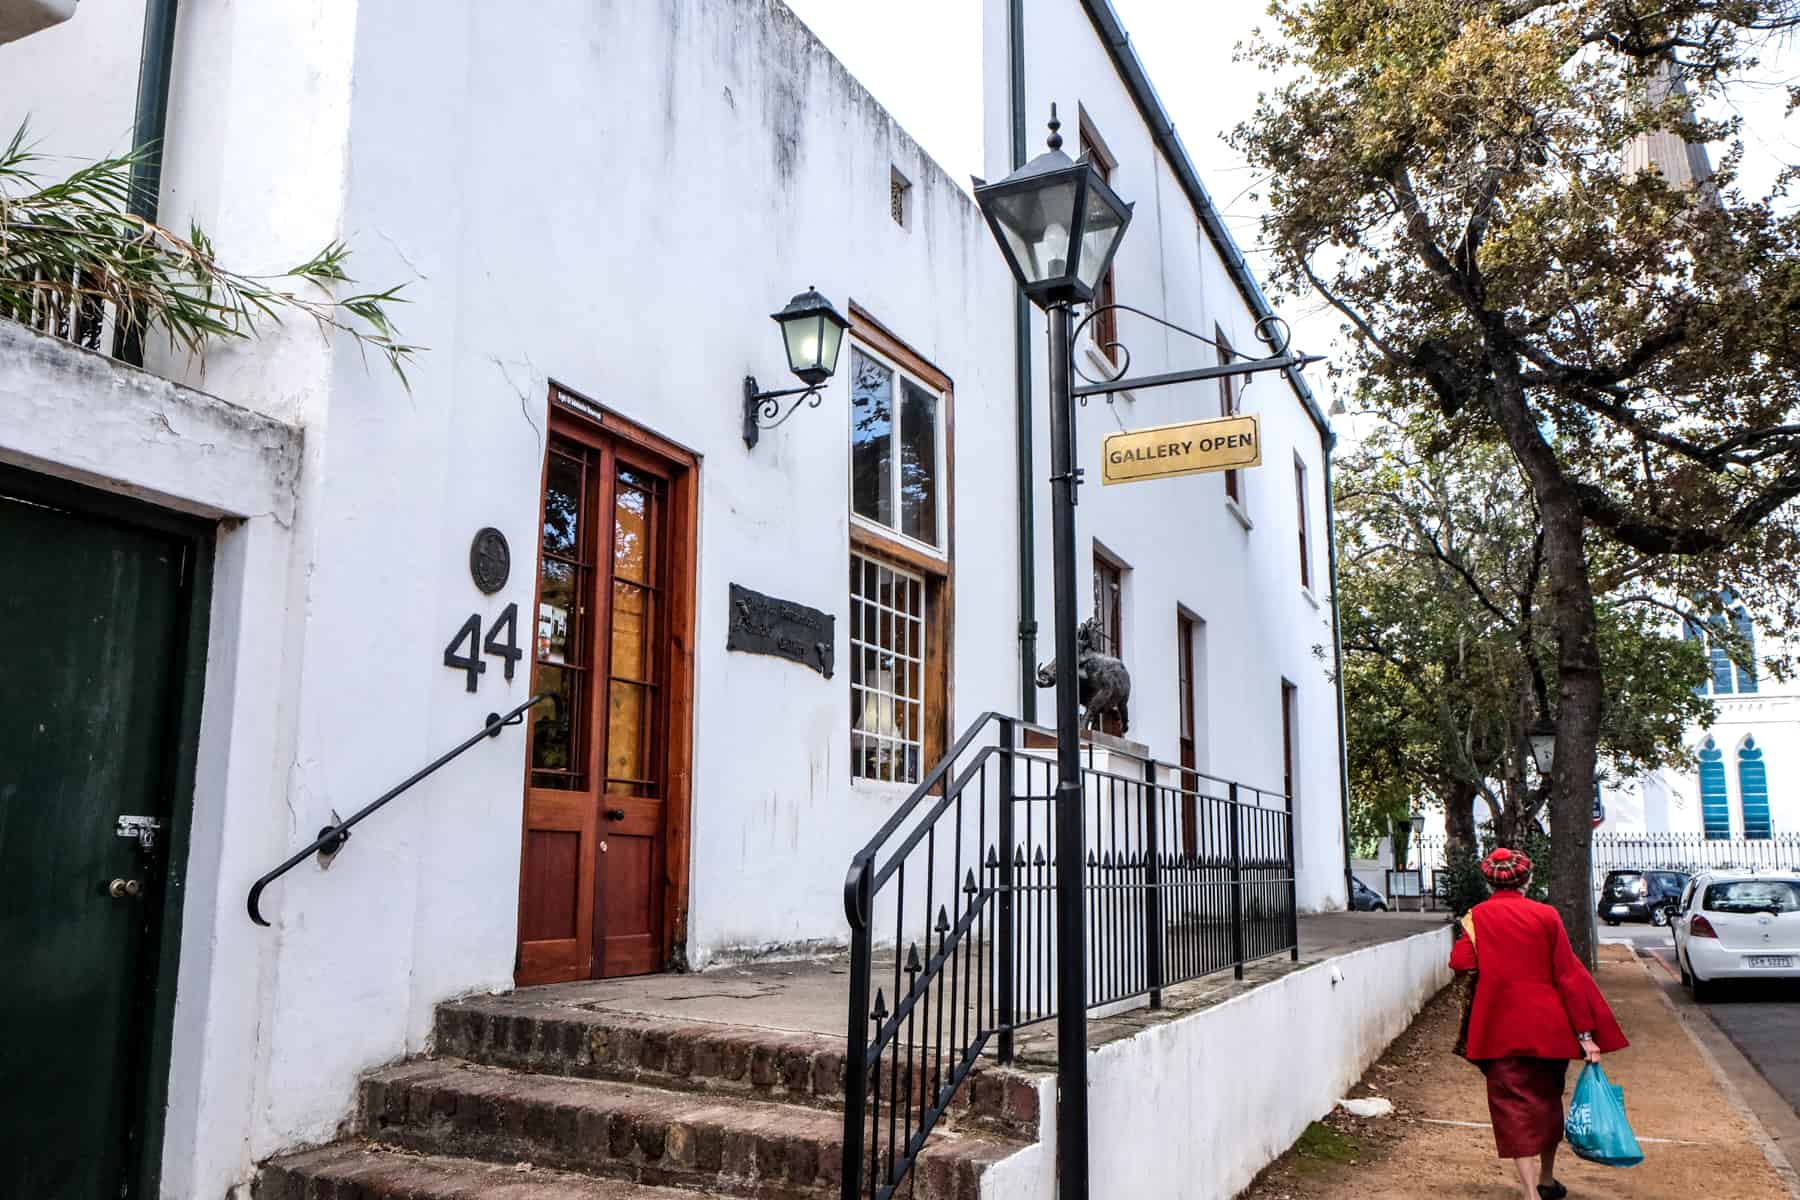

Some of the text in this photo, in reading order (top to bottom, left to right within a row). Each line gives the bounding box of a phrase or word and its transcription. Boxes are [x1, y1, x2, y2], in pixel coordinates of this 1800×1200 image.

[1110, 432, 1252, 465] GALLERY OPEN
[444, 602, 522, 693] 44
